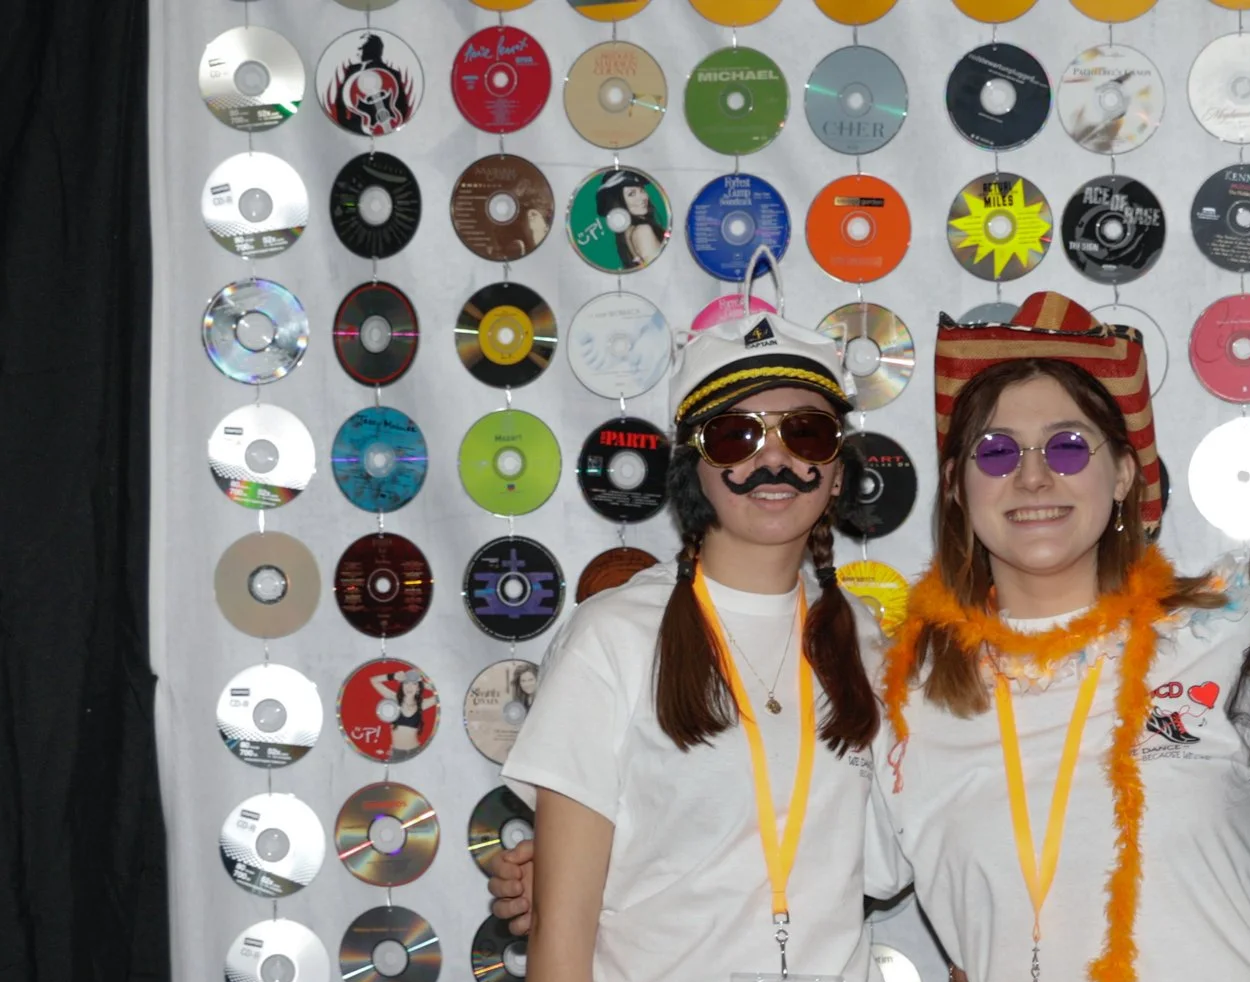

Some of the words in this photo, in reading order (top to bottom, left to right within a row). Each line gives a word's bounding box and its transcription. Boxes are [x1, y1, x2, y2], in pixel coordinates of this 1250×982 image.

[697, 70, 779, 83] MICHAEL
[822, 120, 885, 139] CHER
[984, 195, 1014, 208] MILES
[1082, 186, 1112, 206] ACE
[1110, 194, 1129, 212] OF
[744, 340, 778, 349] CAPTAIN
[606, 432, 660, 450] PARTY
[1142, 745, 1182, 754] DANCE
[1142, 750, 1181, 761] BECAUSE
